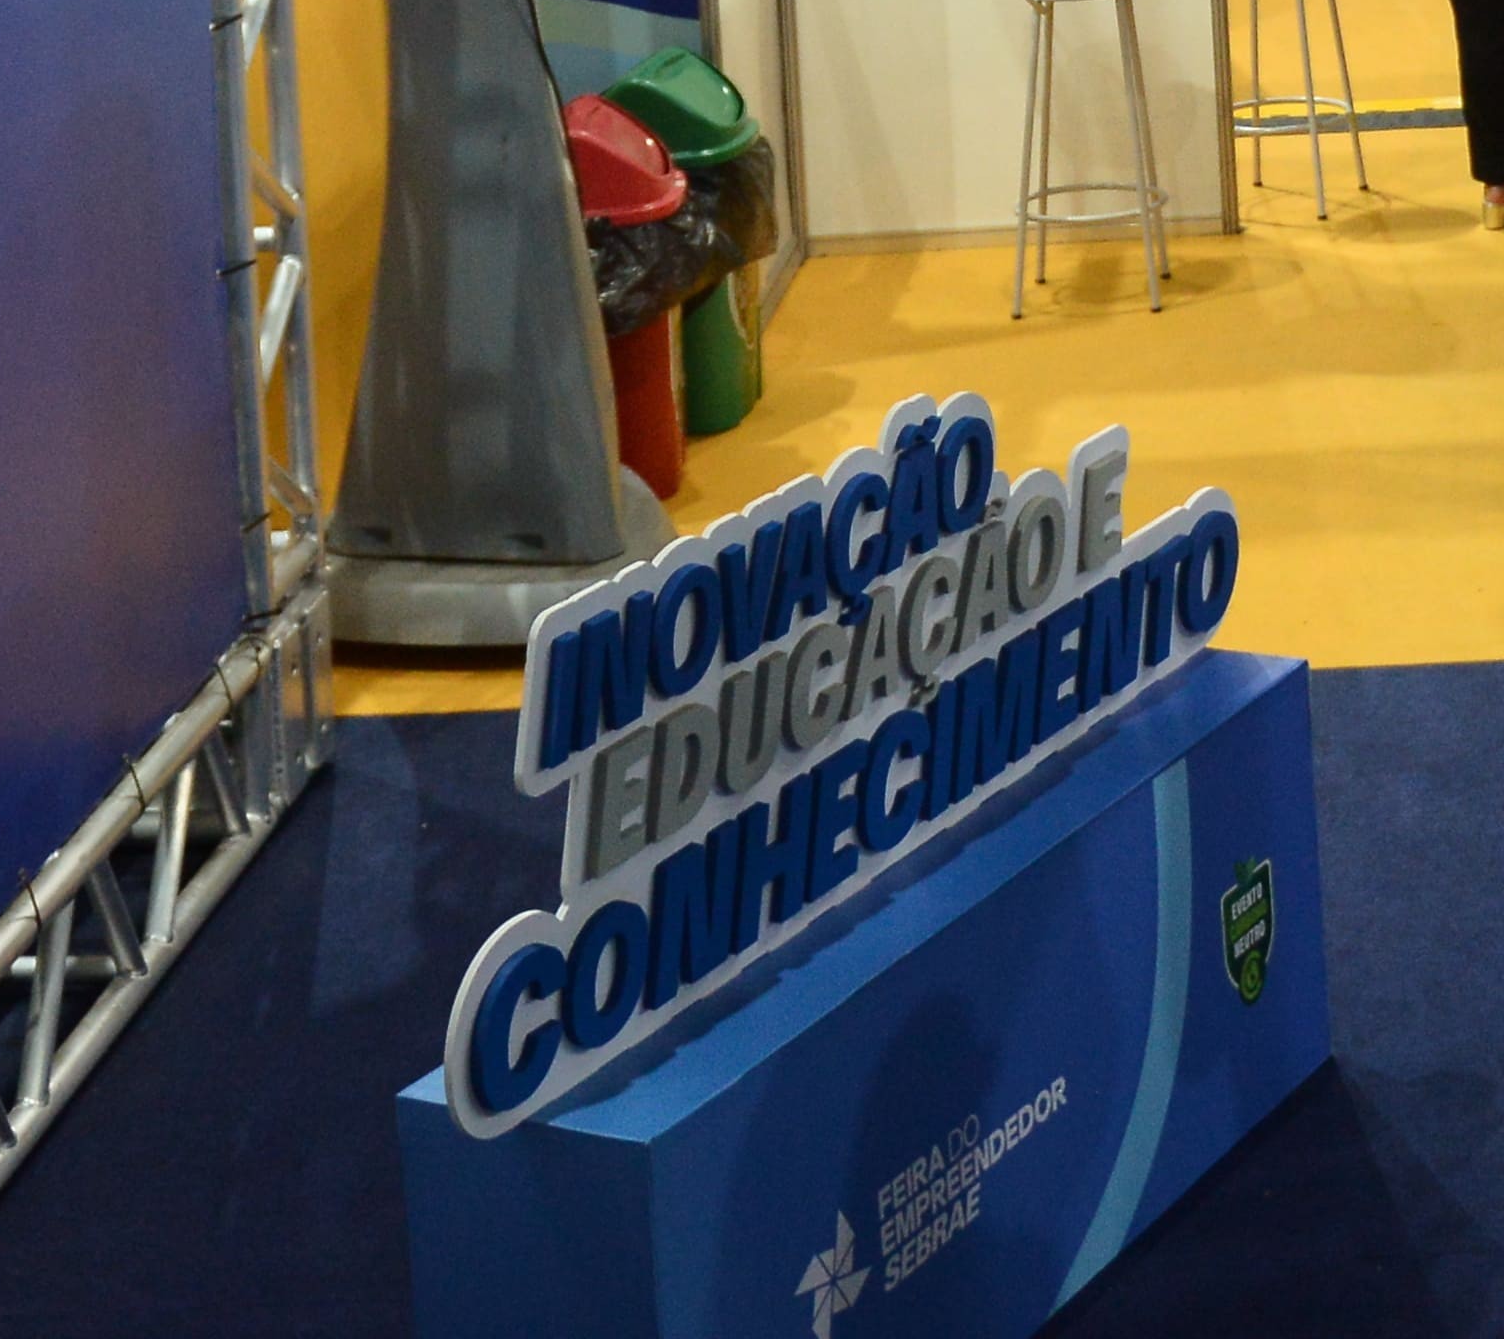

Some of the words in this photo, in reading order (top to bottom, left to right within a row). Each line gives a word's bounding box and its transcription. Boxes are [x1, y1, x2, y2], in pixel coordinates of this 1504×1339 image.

[539, 412, 995, 769] INOVAÇÃO
[587, 490, 1066, 881] EDUCAÇÃO
[1079, 449, 1127, 573] E
[470, 509, 1239, 1113] CONHECIMENTO
[877, 1143, 945, 1219] FEIRA
[947, 1113, 982, 1163] DO
[880, 1075, 1068, 1258] EMPREENDEDOR
[883, 1182, 982, 1293] SEBRAE
